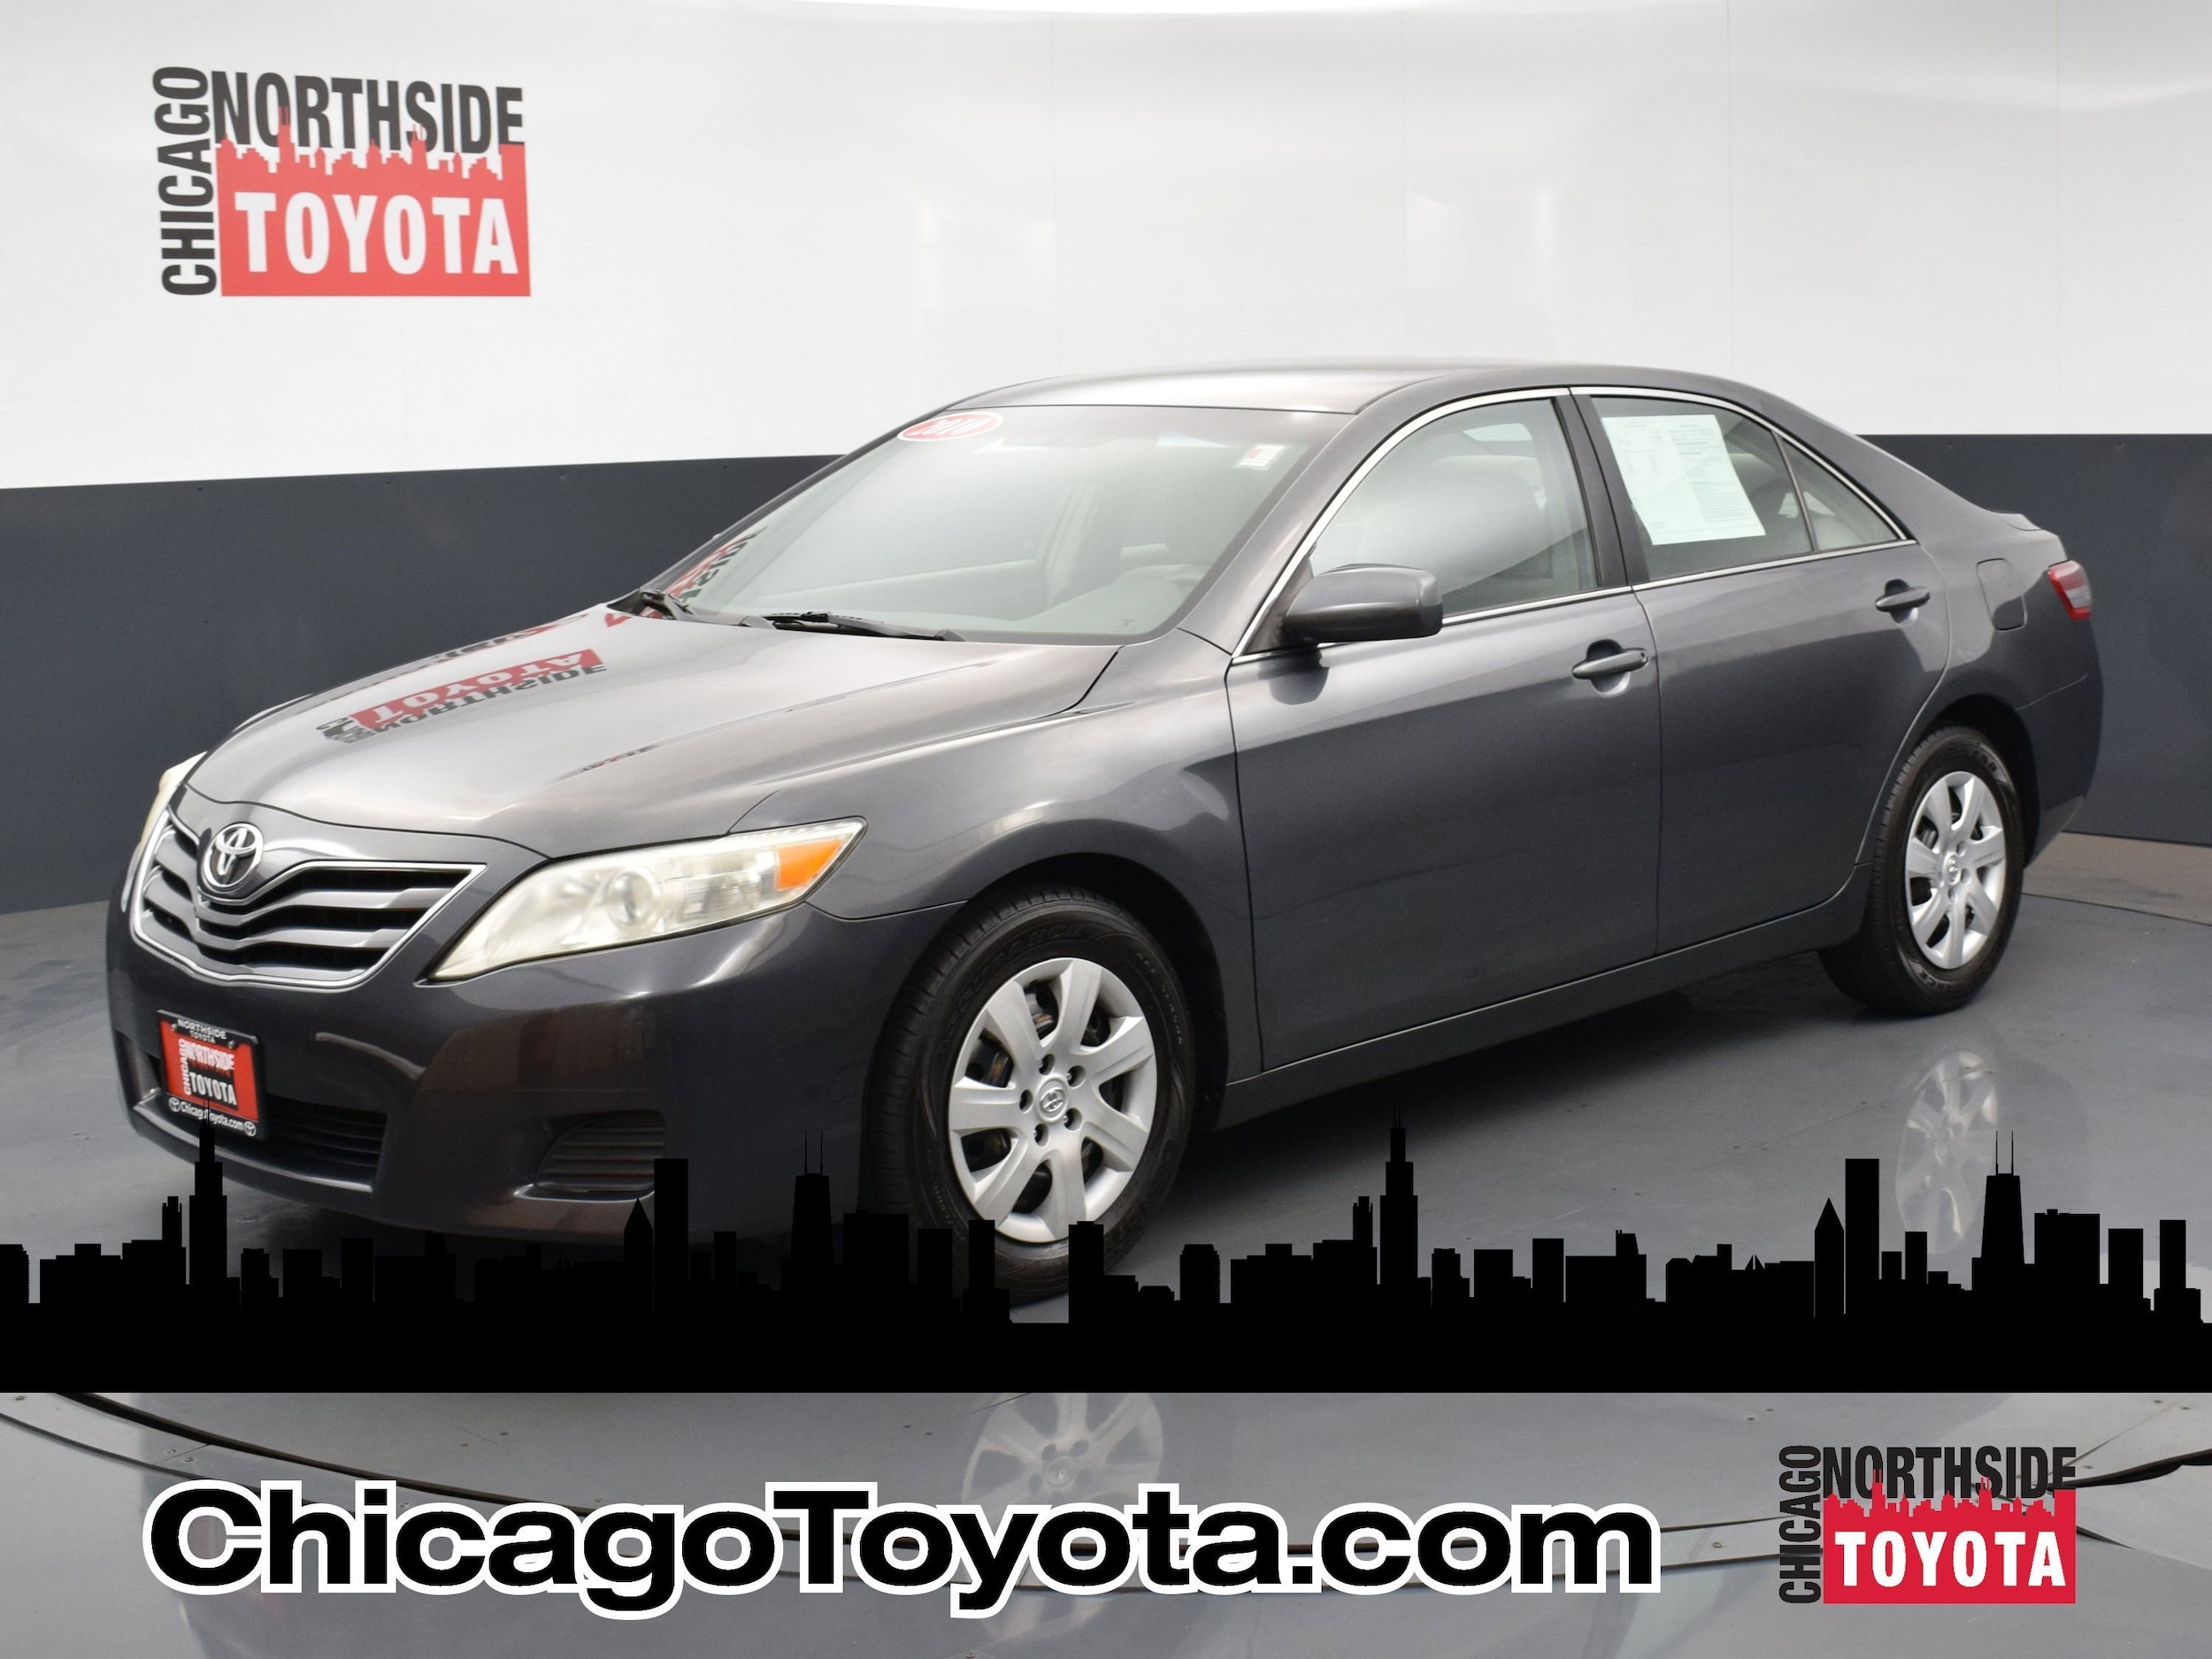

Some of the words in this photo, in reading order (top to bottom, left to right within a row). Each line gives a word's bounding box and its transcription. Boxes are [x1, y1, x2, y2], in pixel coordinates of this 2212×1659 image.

[211, 71, 525, 154] NORTHSIDE
[152, 66, 217, 296] CHICAGO
[234, 192, 518, 275] TOYOTA
[177, 1018, 227, 1040] NORTHSIDE
[189, 1030, 216, 1044] TOYOTA
[179, 1038, 192, 1095] CHICAGO
[184, 1041, 234, 1071] NORTHSIDE
[188, 1071, 237, 1106] TOYOTA
